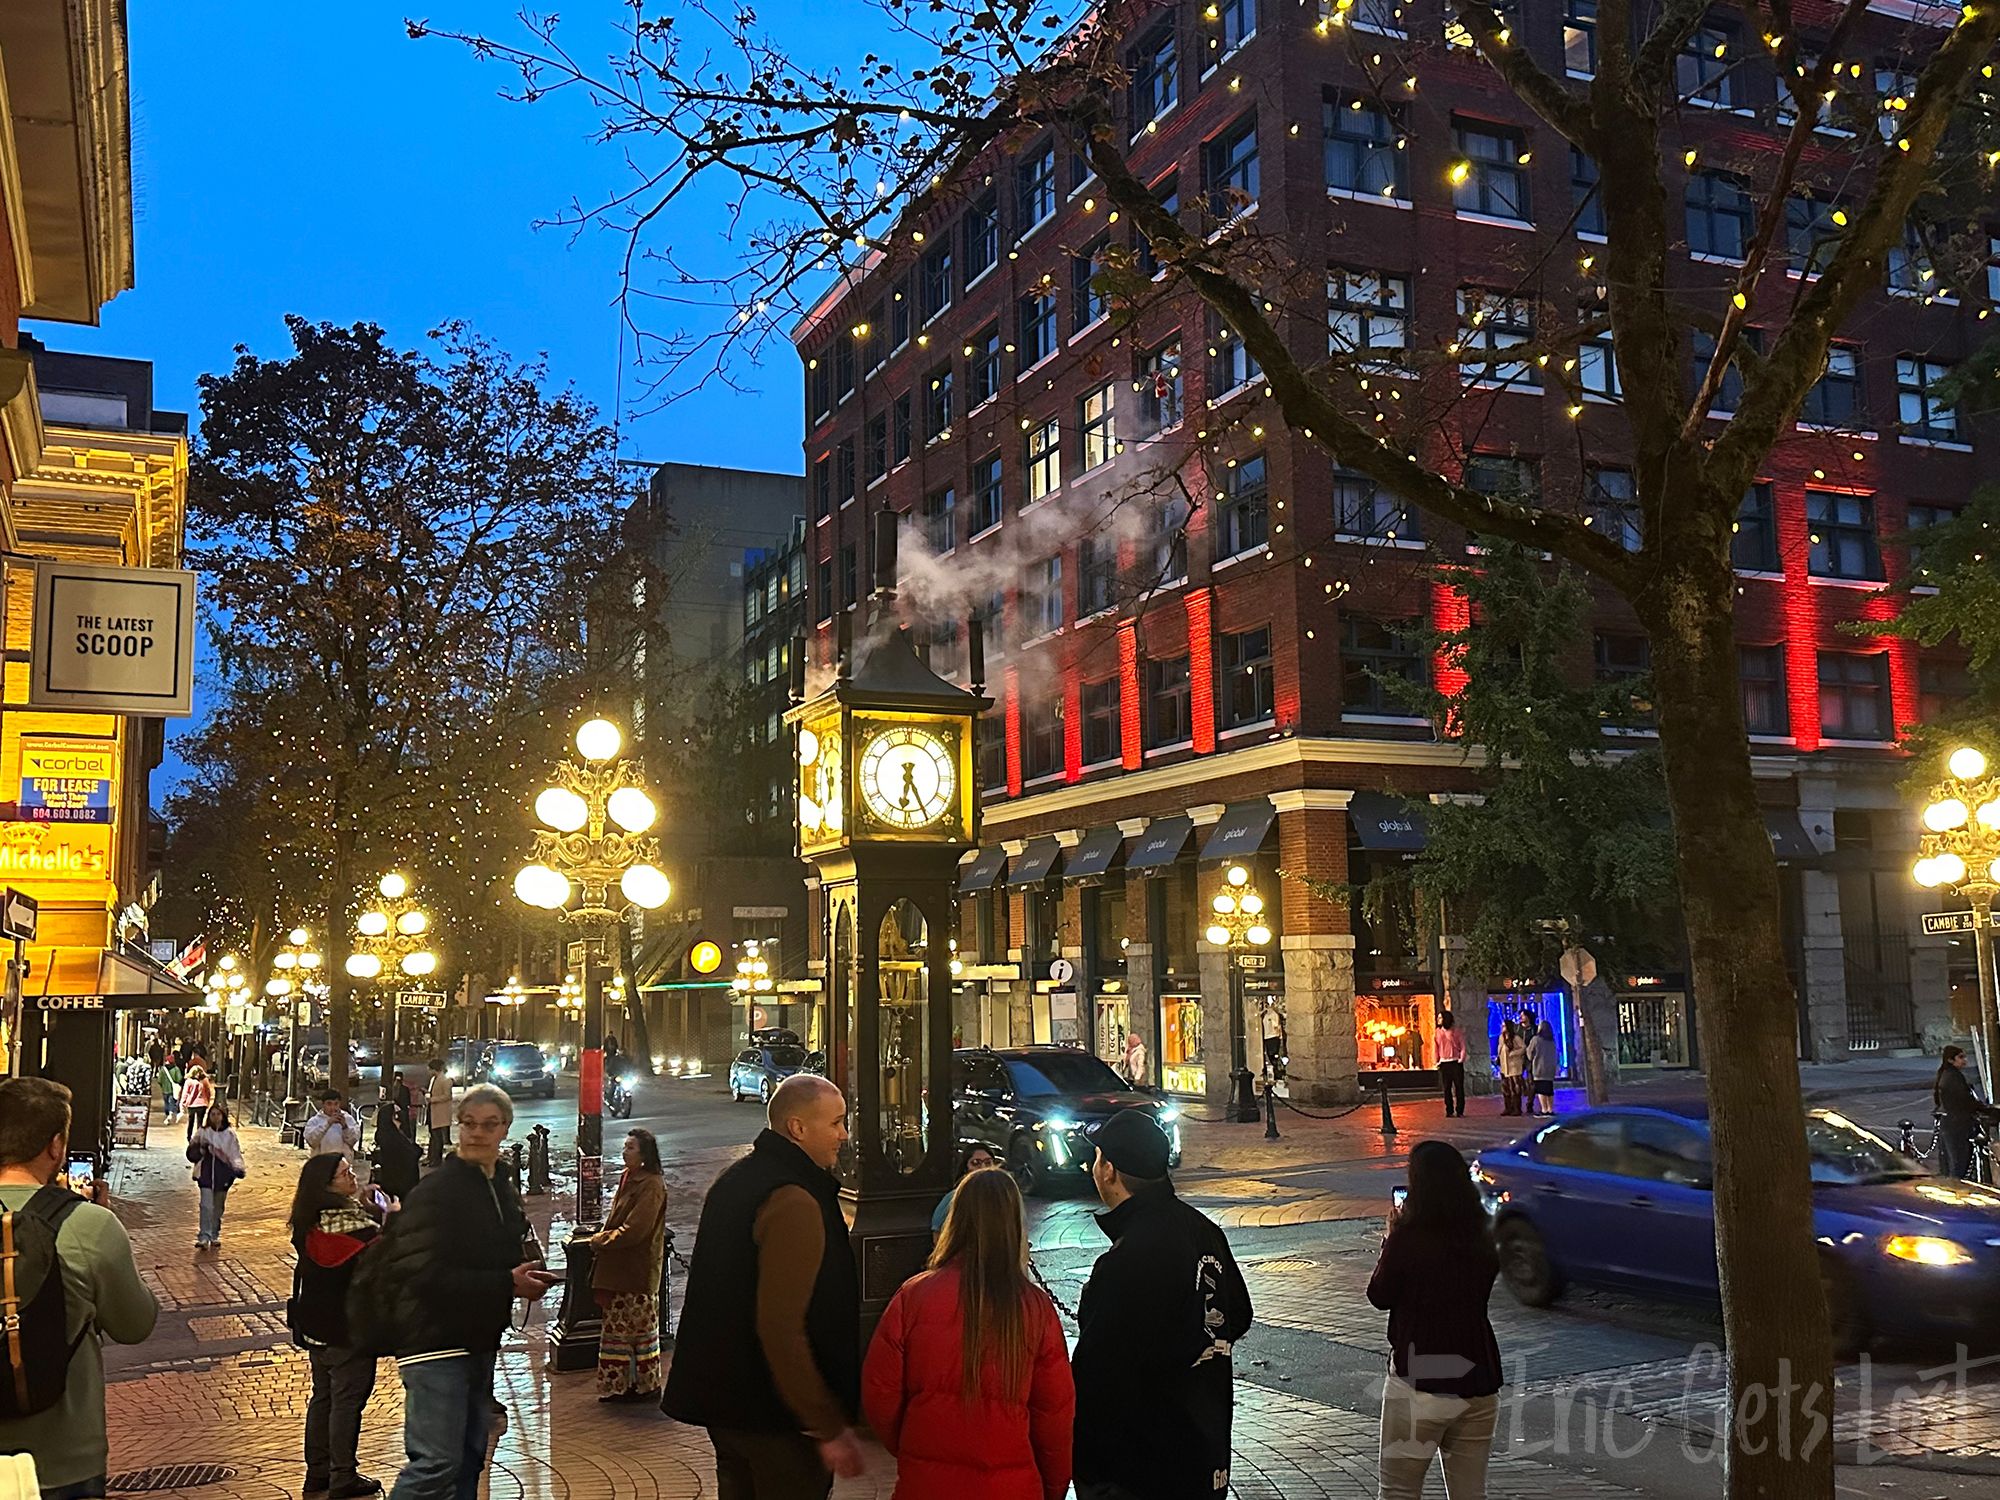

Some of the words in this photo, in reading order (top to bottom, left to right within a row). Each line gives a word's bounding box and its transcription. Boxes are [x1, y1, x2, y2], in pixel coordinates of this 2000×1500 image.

[76, 615, 101, 629] THE
[107, 617, 153, 632] LATEST
[76, 633, 153, 657] SCOOP
[43, 757, 104, 771] corbel
[33, 778, 58, 791] FOR
[60, 779, 98, 793] LEASE
[32, 807, 96, 820] 604.609.0882
[1378, 820, 1412, 833] global
[1223, 826, 1248, 842] global
[1146, 838, 1169, 852] global
[1927, 916, 1959, 930] CAMBIE
[1382, 979, 1400, 988] global
[37, 996, 104, 1010] COFFEE
[402, 994, 430, 1005] CAMBIE
